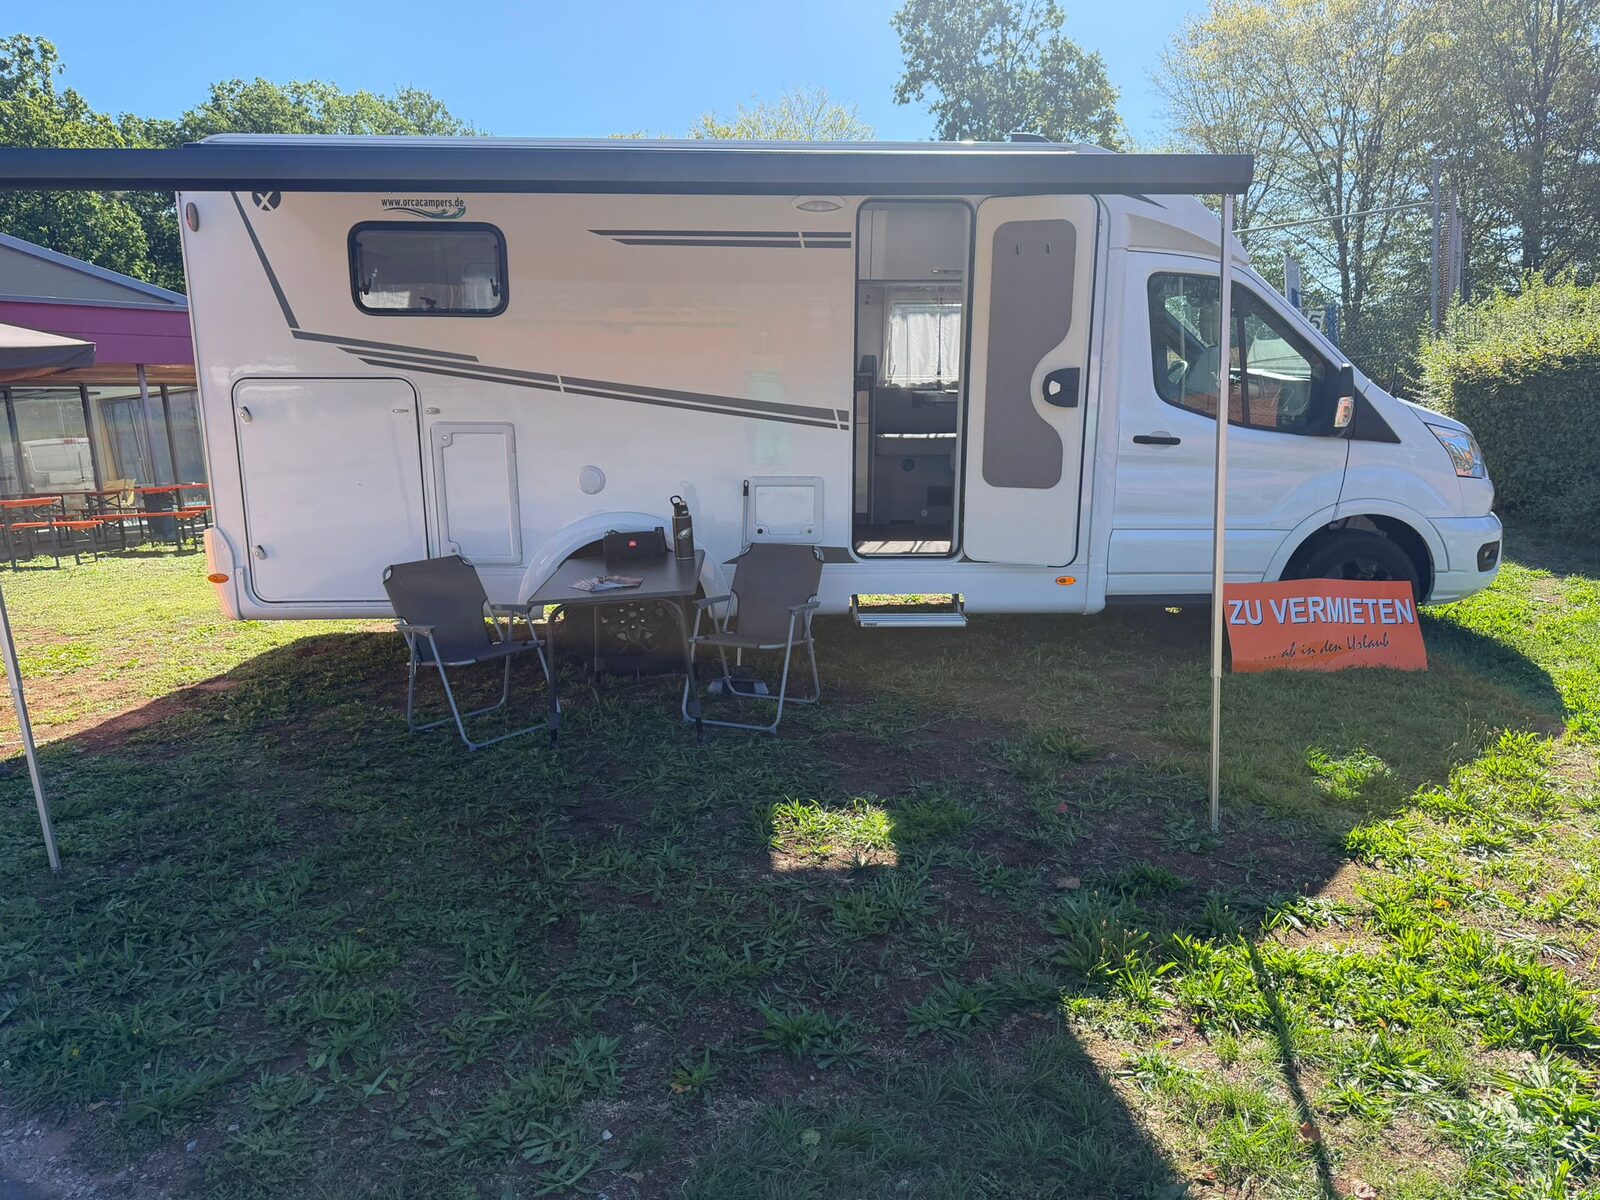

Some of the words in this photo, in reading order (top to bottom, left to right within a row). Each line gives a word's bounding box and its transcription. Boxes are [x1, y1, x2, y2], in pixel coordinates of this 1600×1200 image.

[381, 197, 465, 209] www.orcacampers.de
[1228, 599, 1263, 625] ZU
[1269, 596, 1415, 625] VERMIETEN
[1300, 644, 1316, 656] in
[1319, 639, 1343, 655] den
[1346, 632, 1390, 651] Urlaub
